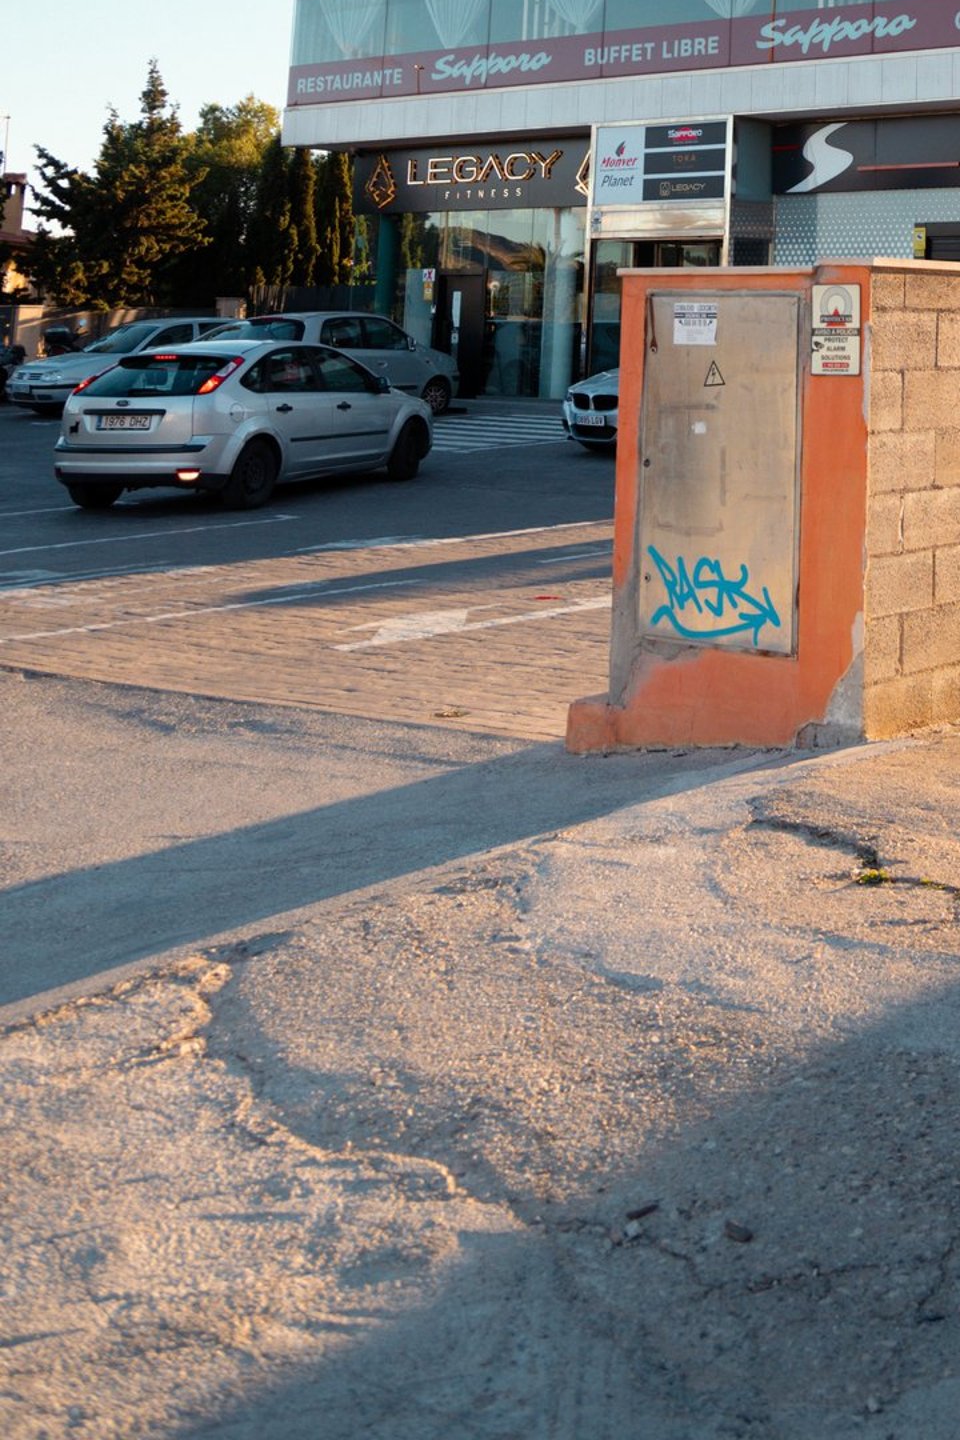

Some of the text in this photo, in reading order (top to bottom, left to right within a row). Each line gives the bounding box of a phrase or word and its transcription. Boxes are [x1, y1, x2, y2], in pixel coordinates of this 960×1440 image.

[755, 13, 917, 54] Sapporo
[584, 36, 720, 67] BUFFET LIBRE
[297, 68, 403, 94] RESTAURANTE
[431, 49, 551, 85] Sapporo
[407, 149, 563, 185] LEGACY
[600, 174, 635, 188] Planet
[445, 187, 522, 200] FITNESS
[671, 183, 706, 192] LEGACY
